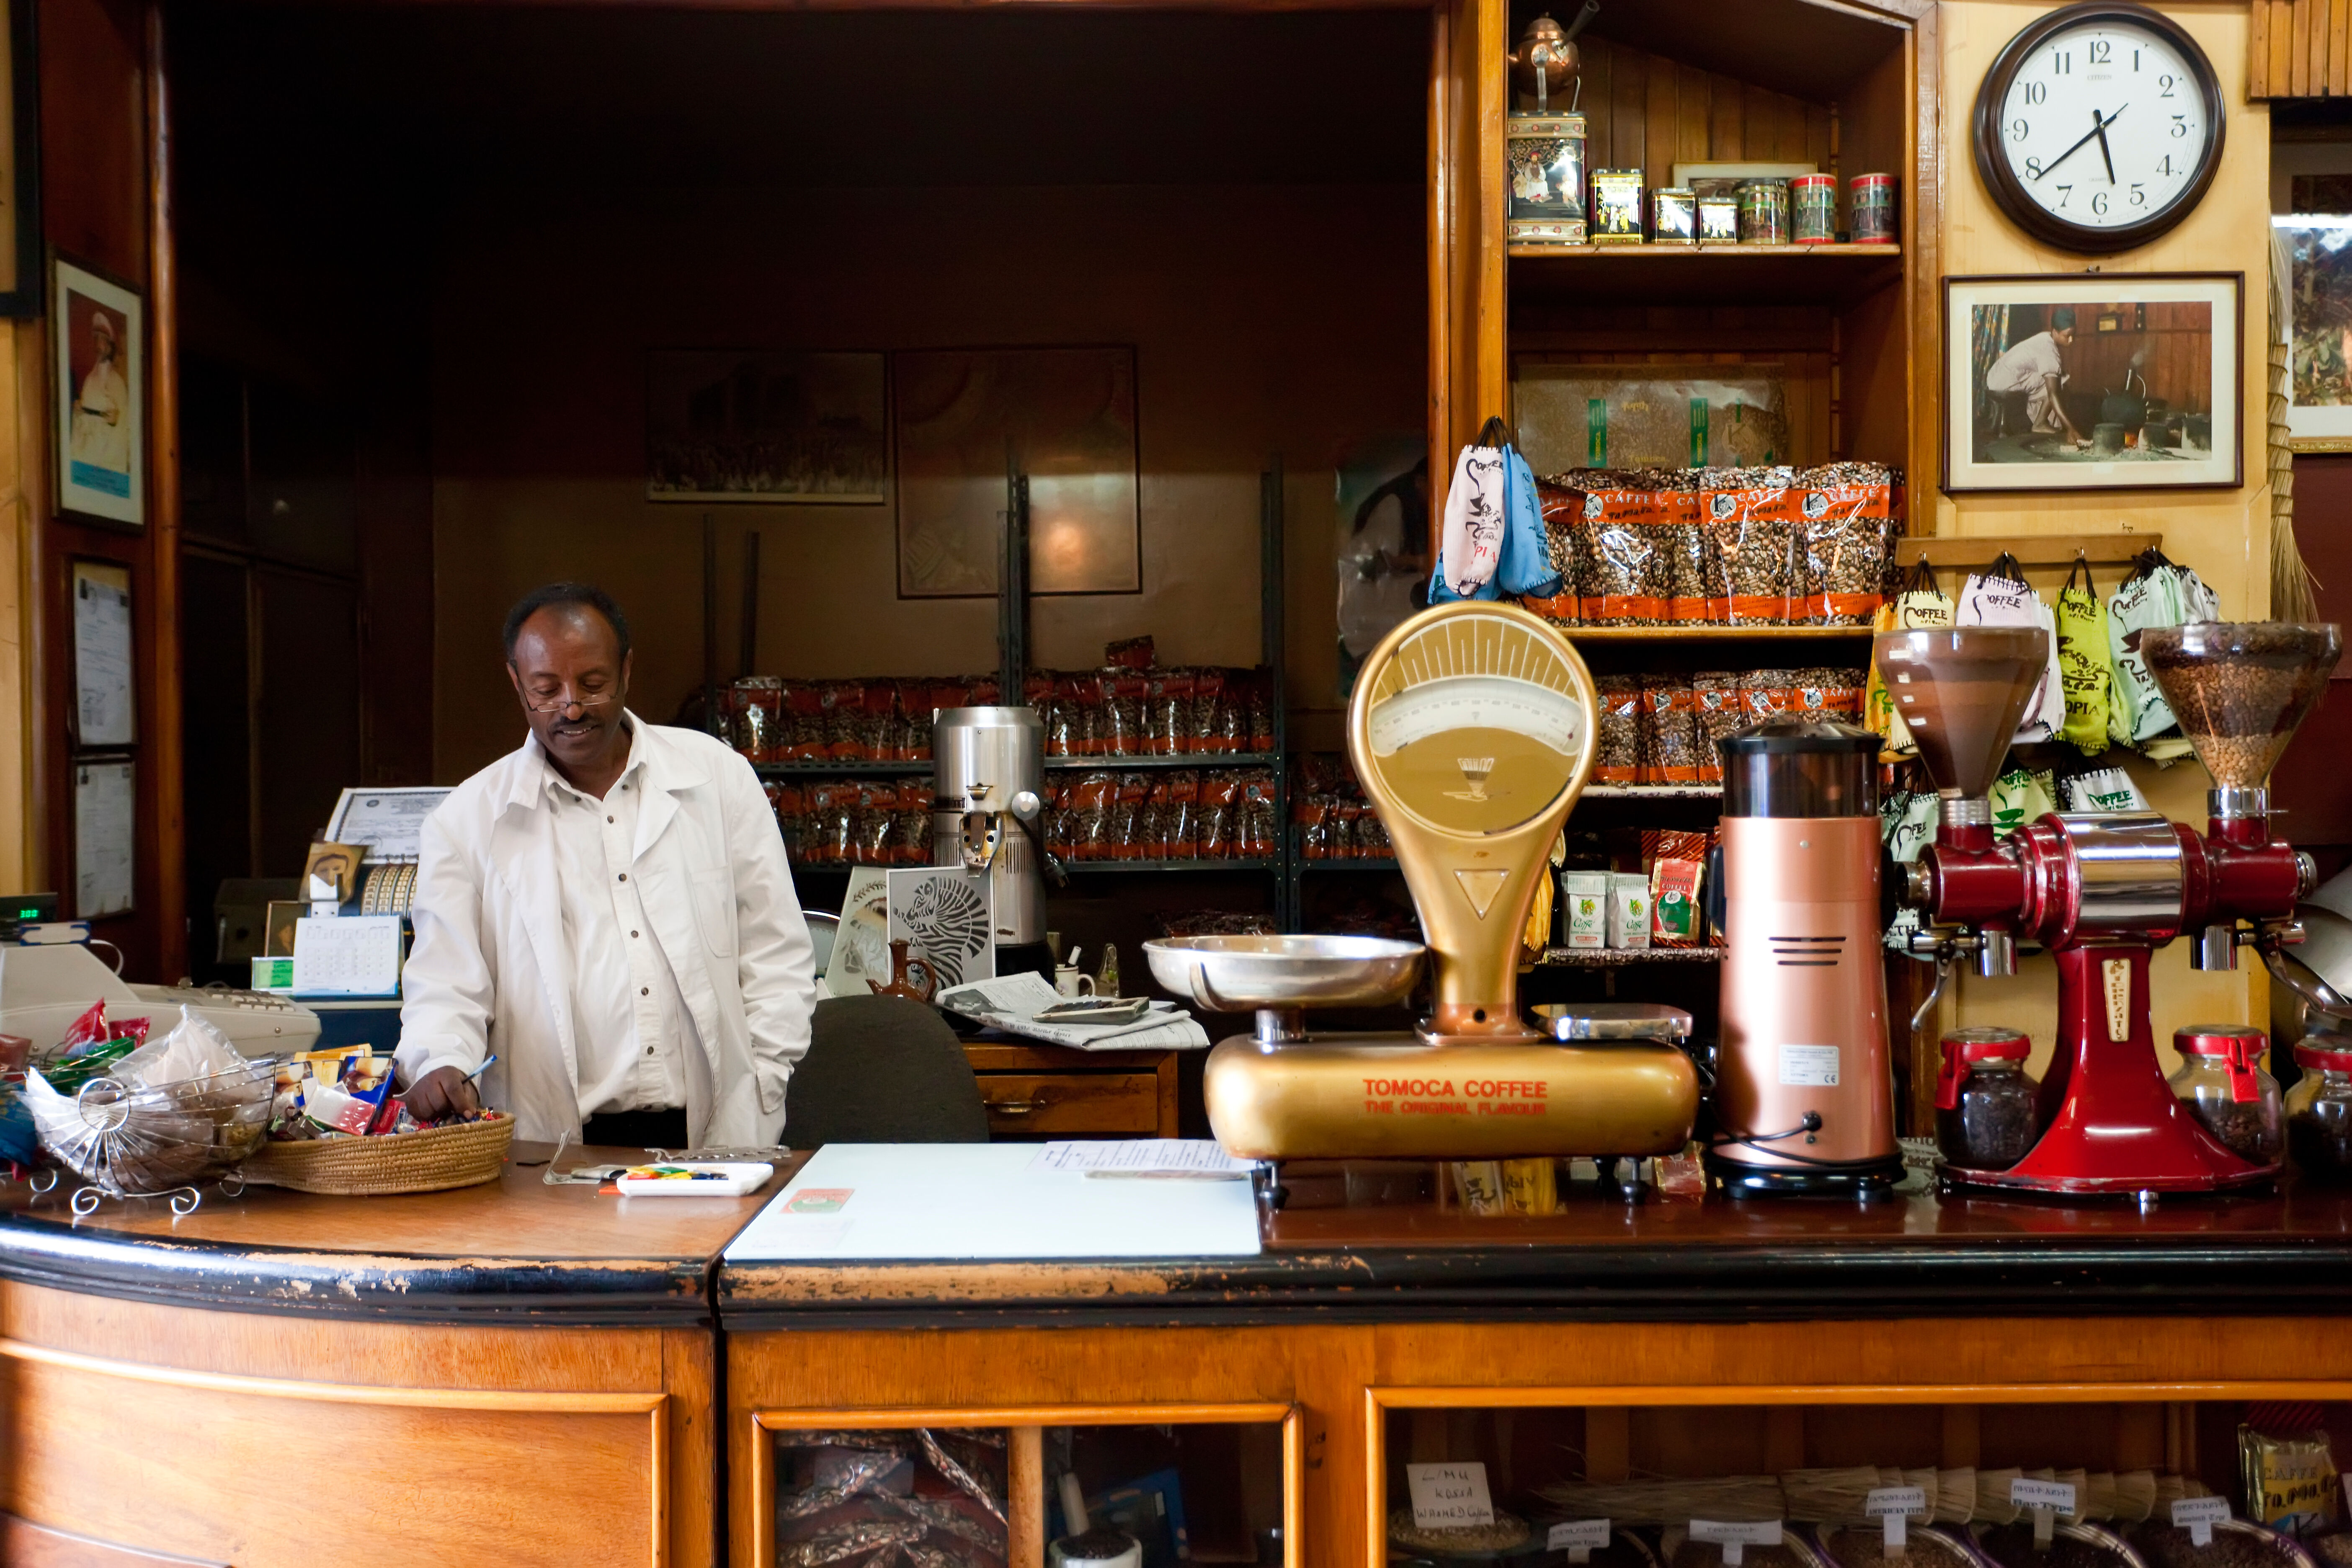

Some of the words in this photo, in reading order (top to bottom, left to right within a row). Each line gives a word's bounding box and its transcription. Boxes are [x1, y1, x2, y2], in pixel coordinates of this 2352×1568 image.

[2055, 52, 2070, 74] 11
[2089, 41, 2111, 64] 12
[2133, 49, 2140, 72] 1
[2025, 81, 2046, 105] 10
[2159, 75, 2175, 98] 2
[2013, 119, 2028, 142] 9
[2171, 114, 2187, 138] 3
[2026, 157, 2042, 179] 8
[2156, 154, 2172, 176] 4
[2055, 185, 2072, 207] 7
[2092, 192, 2108, 215] 6
[2130, 183, 2145, 205] 5
[1605, 493, 1650, 505] CAFFE
[1737, 491, 1784, 503] CAFFE
[1363, 1079, 1455, 1097] TOMOCA
[1464, 1081, 1547, 1098] COFFEE
[1364, 1101, 1394, 1114] THE
[1399, 1101, 1471, 1115] ORIGINAL
[1477, 1102, 1546, 1116] FLAVOUR
